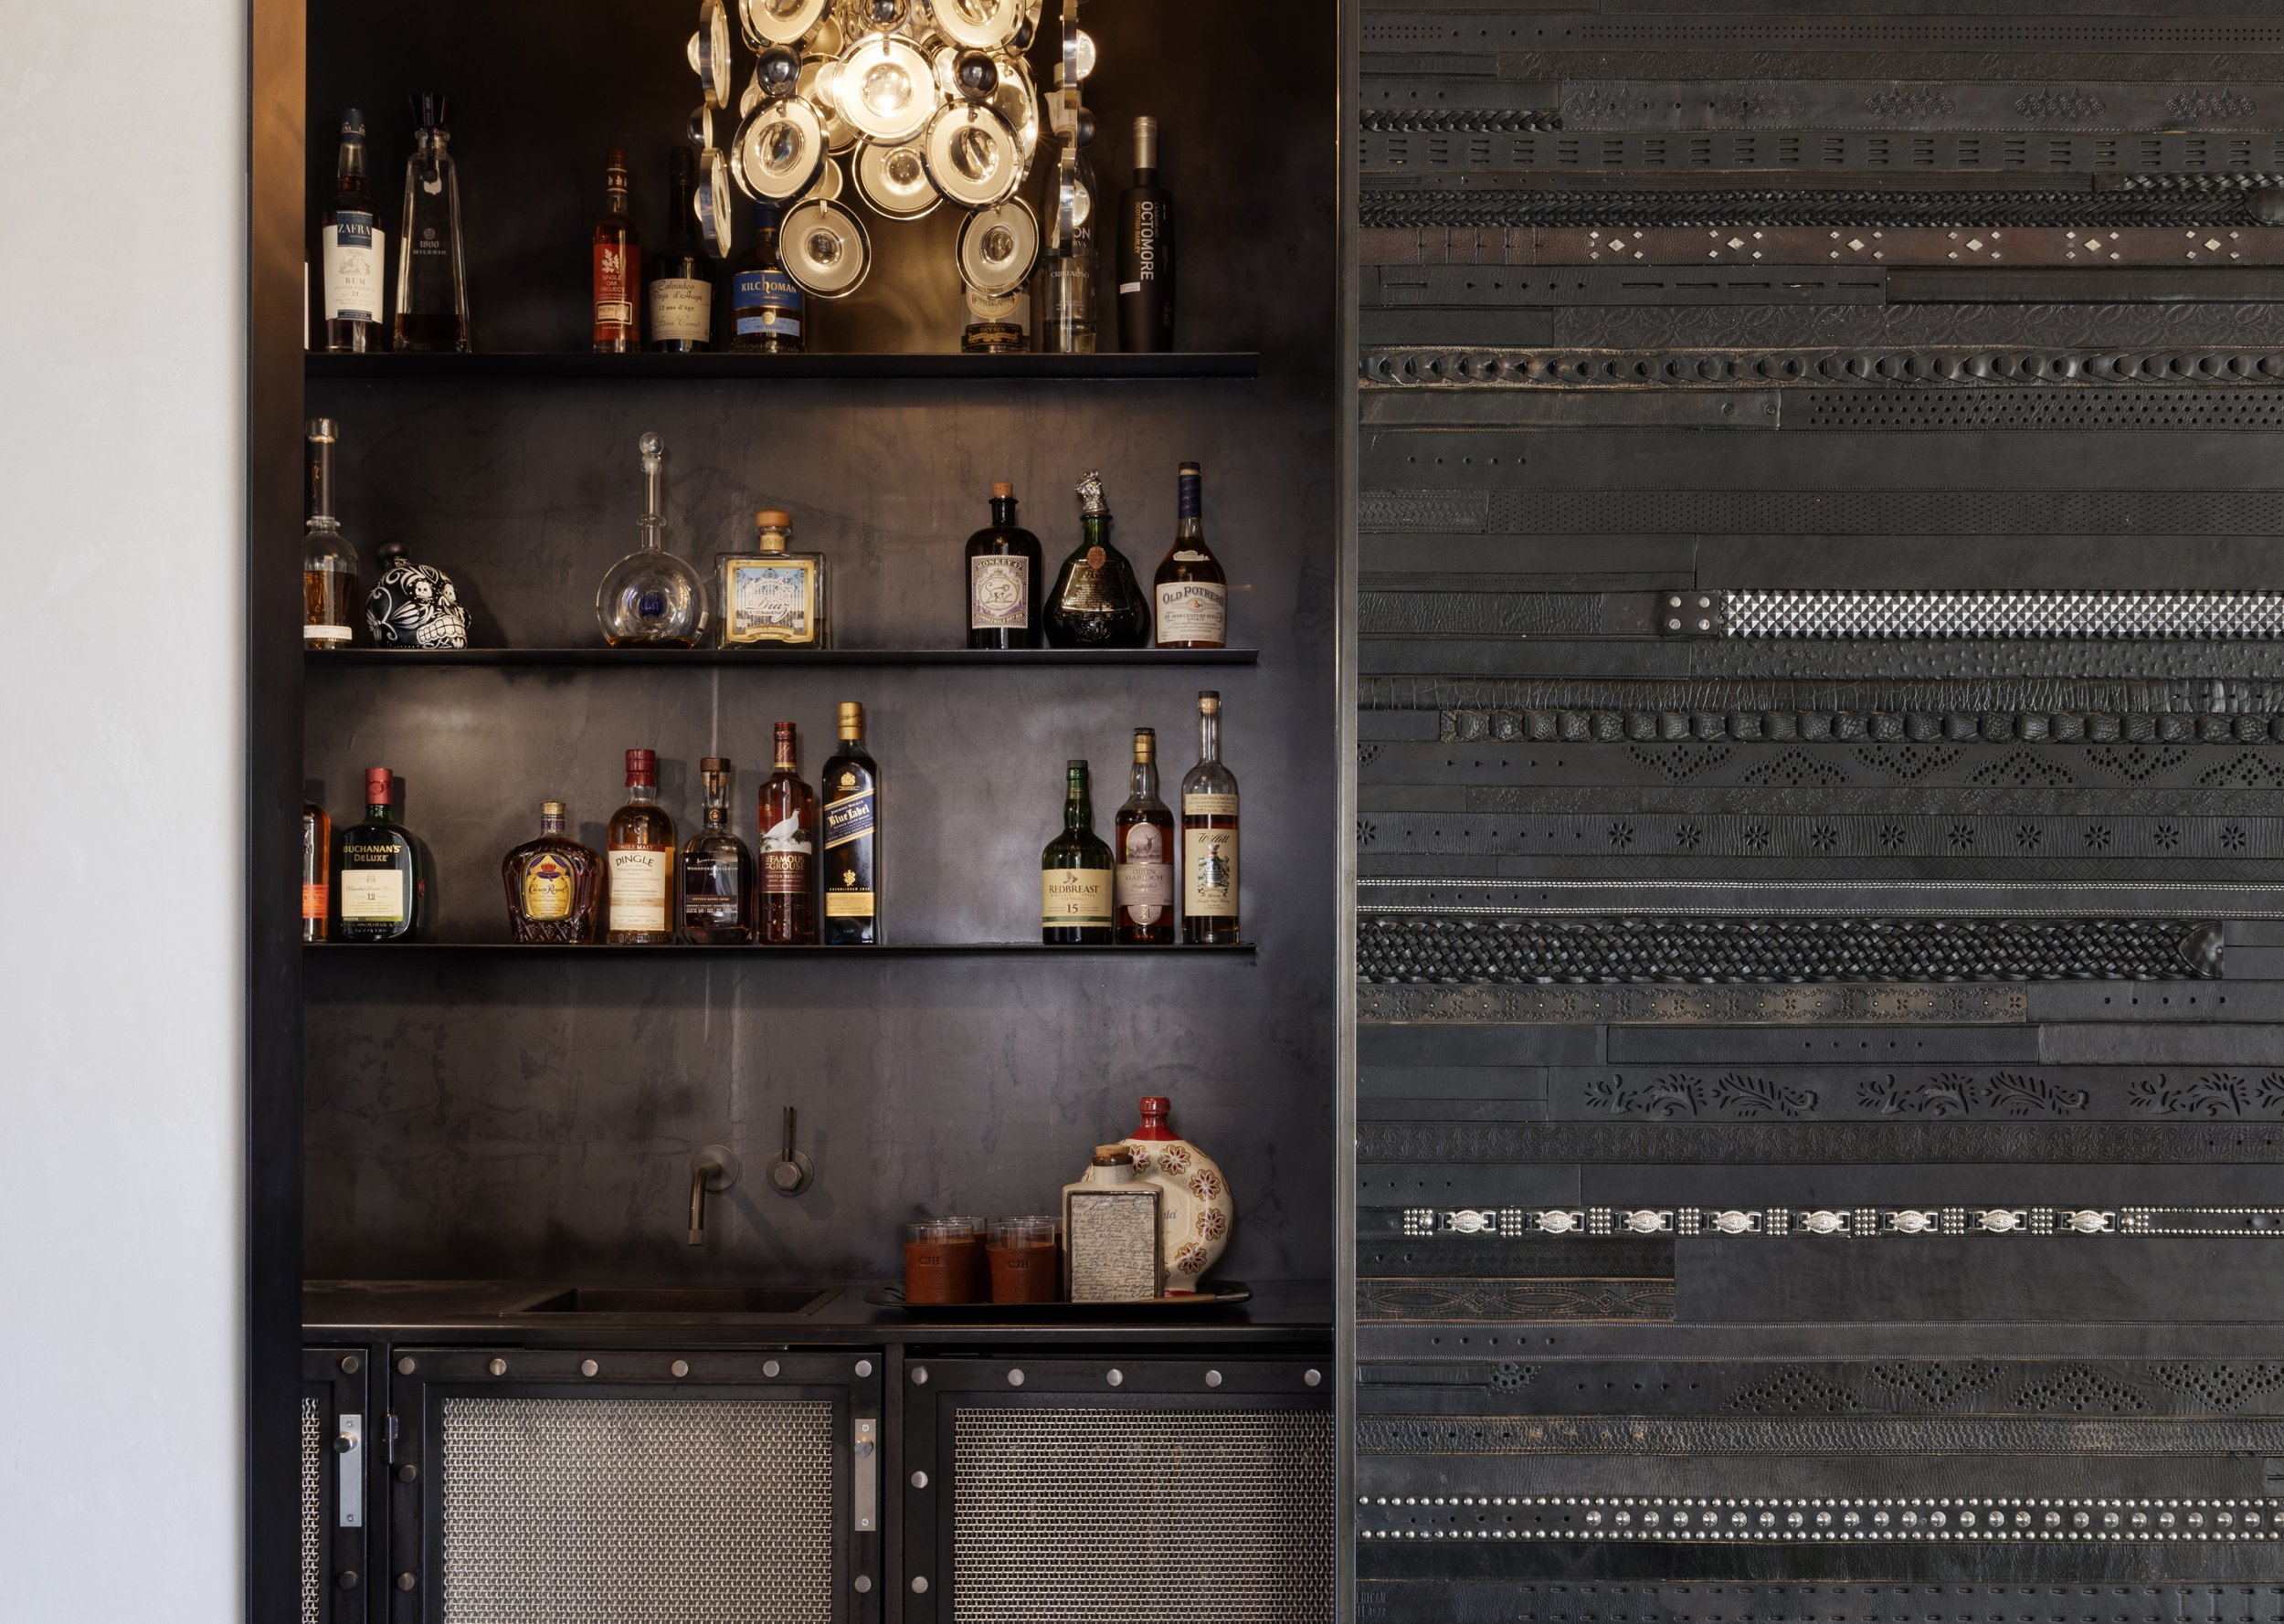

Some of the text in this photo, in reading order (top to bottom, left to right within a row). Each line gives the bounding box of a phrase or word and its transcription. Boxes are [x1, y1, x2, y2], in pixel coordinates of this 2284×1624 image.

[337, 223, 372, 237] ZAFRA
[419, 240, 439, 248] 1800
[1140, 200, 1154, 280] OCTOMORE
[1051, 270, 1090, 279] CRISTALINO
[345, 277, 365, 285] RUM
[657, 279, 695, 291] Calvados
[976, 558, 1013, 569] MONKEY
[1162, 585, 1225, 606] OLD POTRERO
[845, 803, 871, 821] Label
[343, 845, 401, 854] BUCHANAN'S
[615, 854, 655, 868] DINGLE
[769, 855, 805, 863] FAMOUS
[769, 862, 805, 870] GROUSE
[1049, 884, 1098, 894] REDBREAST
[366, 892, 375, 901] 12
[1066, 903, 1079, 914] 15
[919, 1257, 941, 1266] CJH
[1008, 1260, 1031, 1270] CJH
